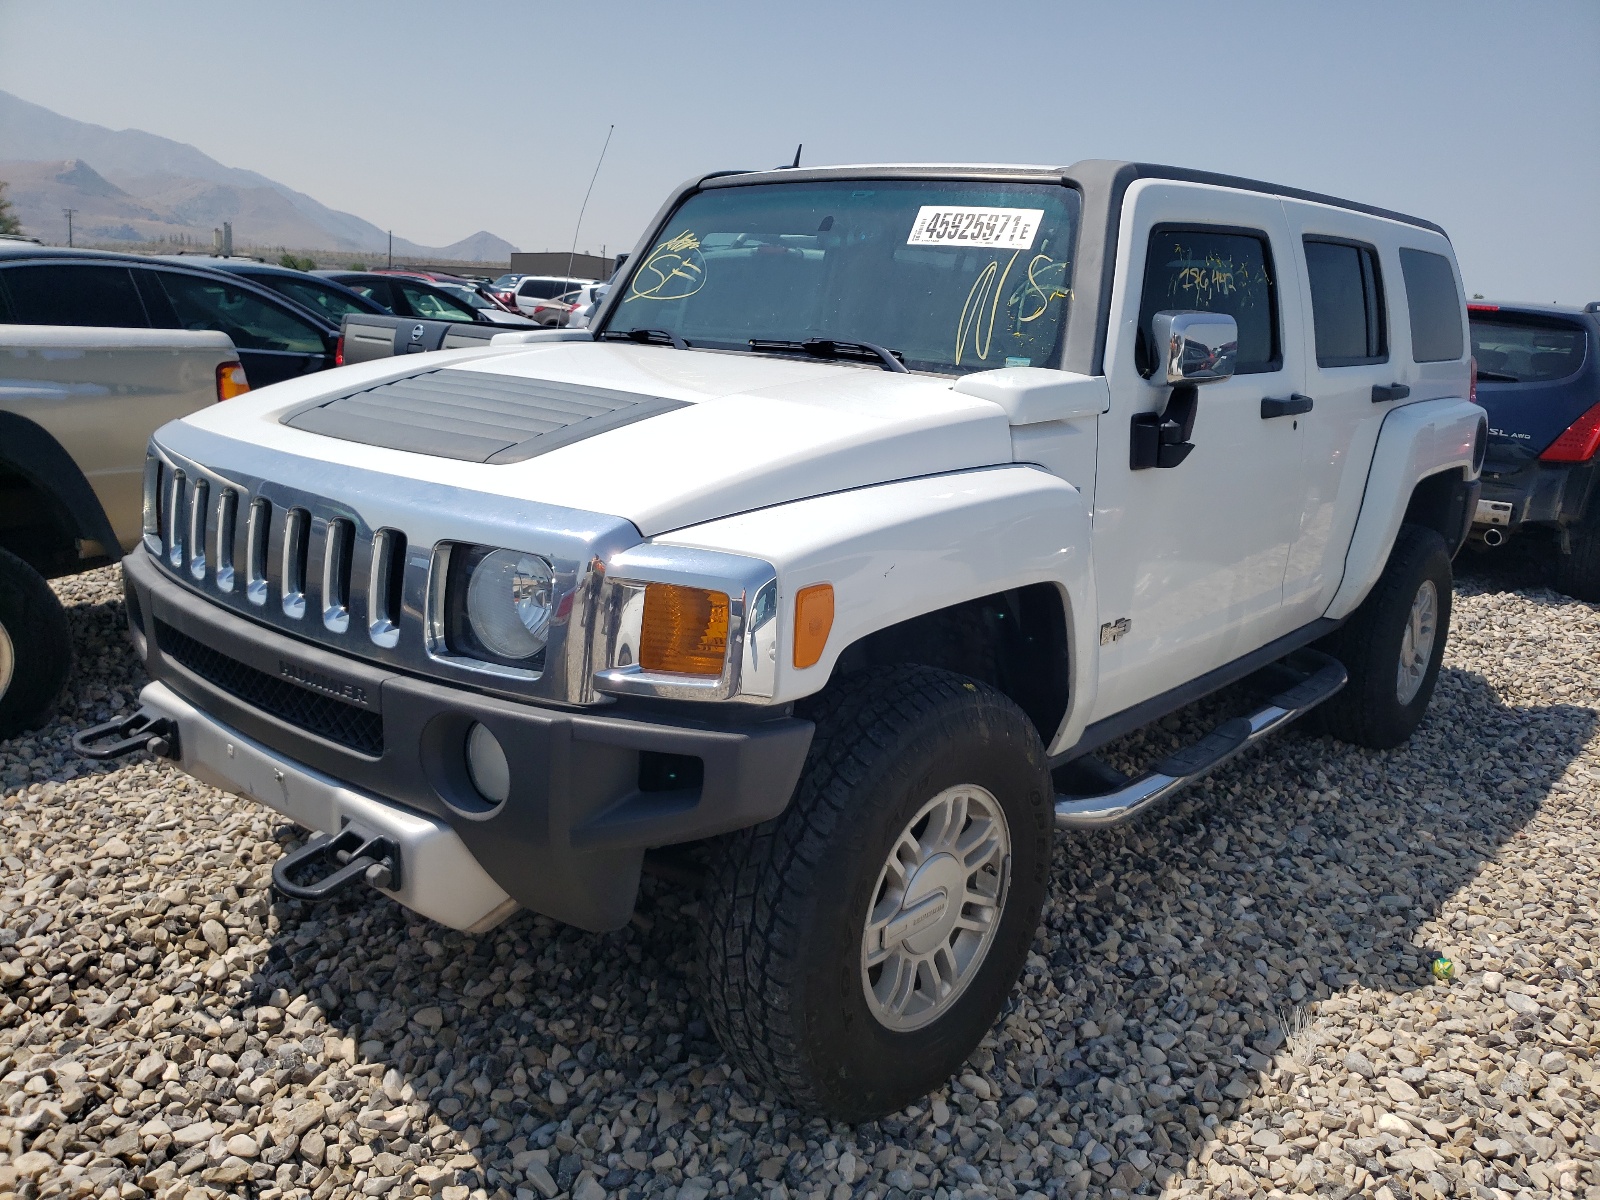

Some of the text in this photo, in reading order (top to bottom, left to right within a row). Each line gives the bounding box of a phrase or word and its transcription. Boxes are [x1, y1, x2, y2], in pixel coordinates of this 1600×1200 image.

[925, 212, 1022, 242] 45925971
[1488, 428, 1531, 440] SL AWD
